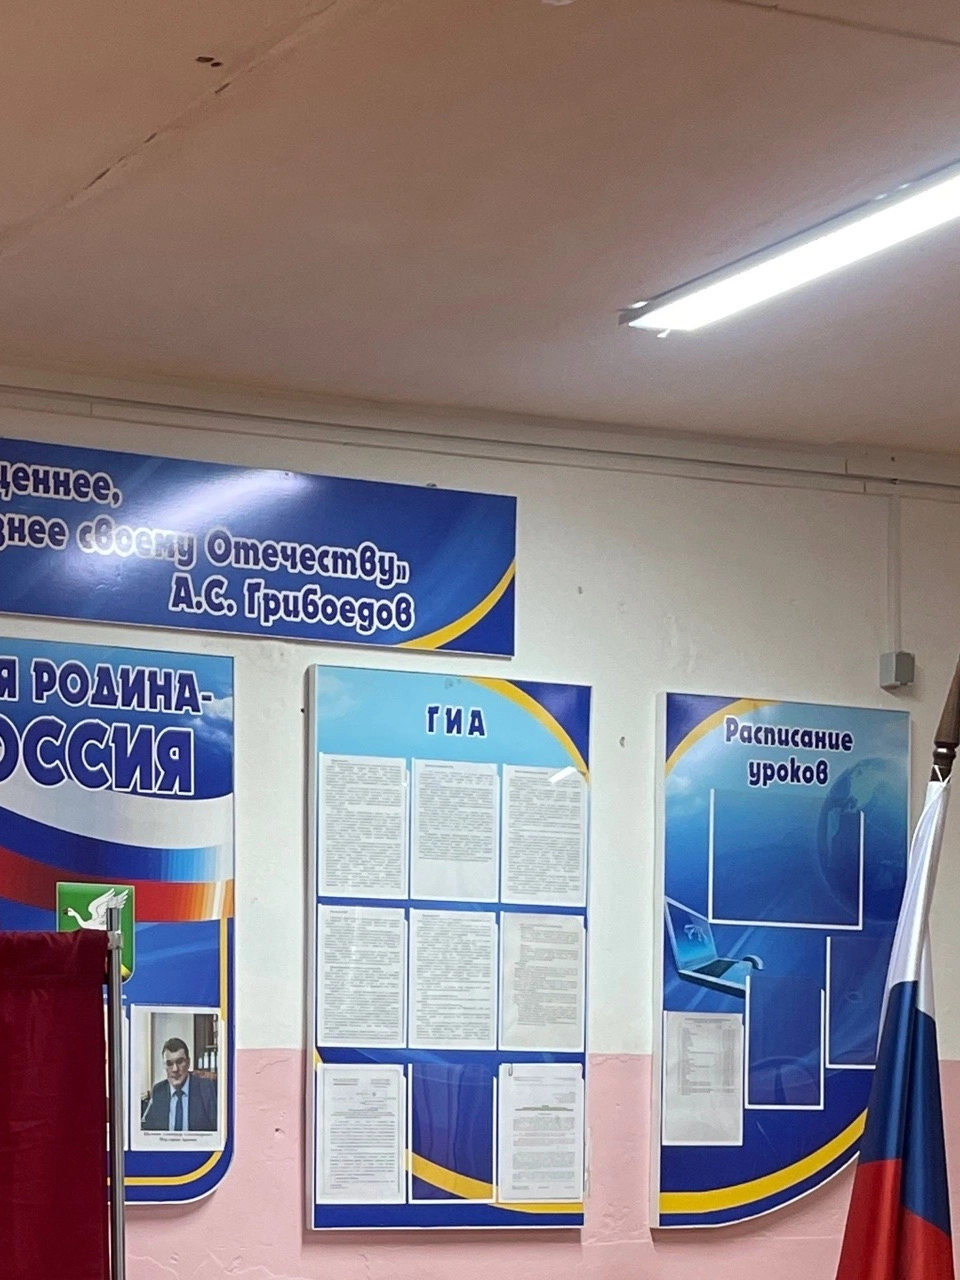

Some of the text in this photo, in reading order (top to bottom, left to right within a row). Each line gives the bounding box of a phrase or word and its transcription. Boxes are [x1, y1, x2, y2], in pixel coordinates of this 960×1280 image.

[76, 516, 197, 567] своему
[170, 573, 415, 633] А.С. Грибоедов
[32, 658, 213, 715] РОДИНА-
[425, 704, 487, 737] ГИА
[724, 716, 854, 752] Расписание
[748, 756, 830, 787] уроков
